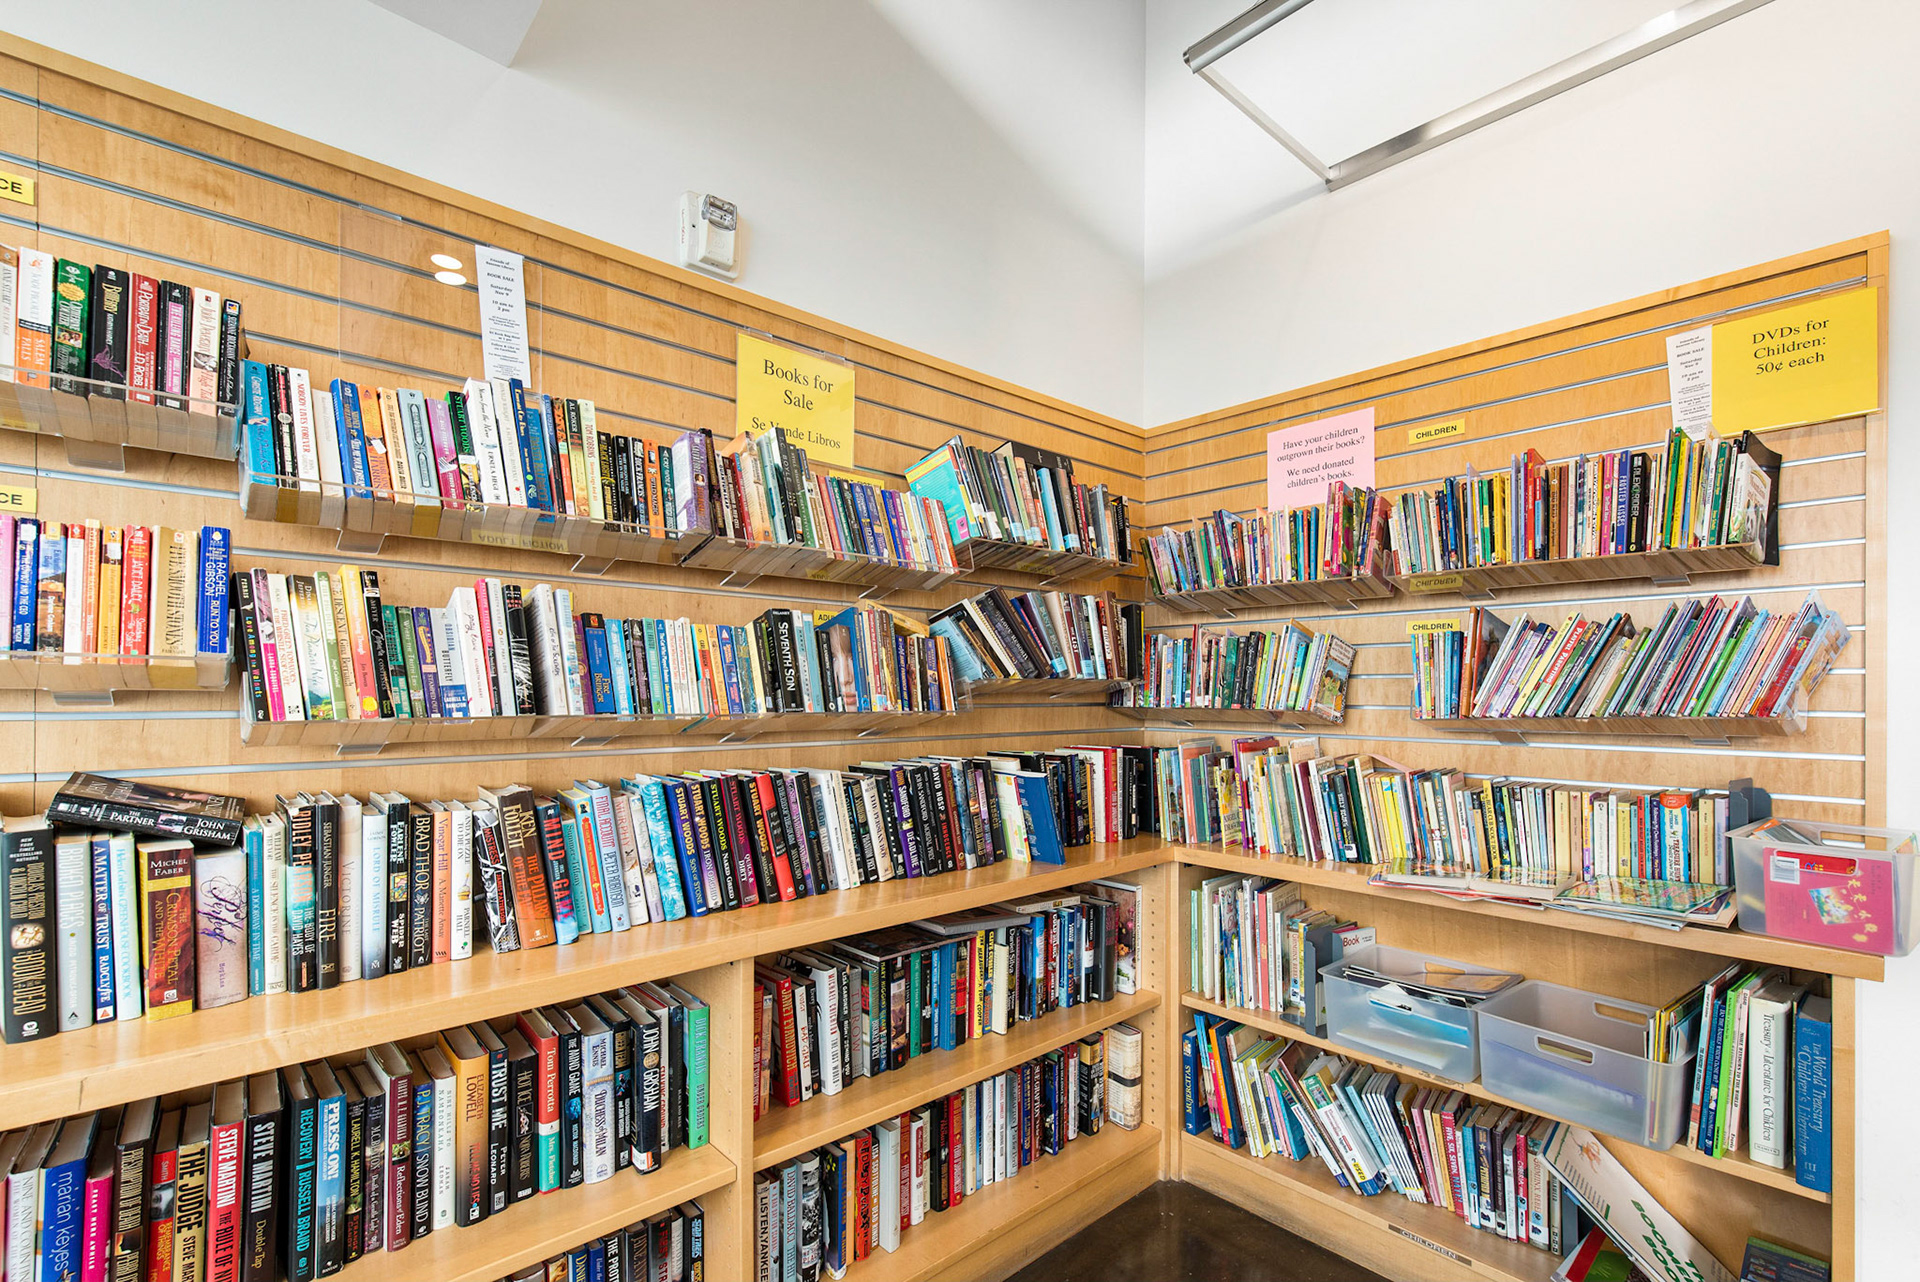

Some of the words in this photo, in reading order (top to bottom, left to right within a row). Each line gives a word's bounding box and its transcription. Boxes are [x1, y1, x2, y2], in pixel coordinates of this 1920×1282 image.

[487, 272, 501, 280] BOOK
[490, 284, 512, 292] Saturday
[1752, 326, 1800, 345] DVDs
[1806, 319, 1830, 332] for
[1753, 336, 1826, 359] Children:
[20, 337, 33, 361] FALLS
[34, 338, 45, 365] SALEM
[1756, 361, 1783, 375] 50¢
[1789, 352, 1825, 368] each
[134, 365, 145, 387] ROBB
[764, 359, 809, 386] Books
[814, 375, 834, 393] for
[453, 395, 466, 424] STUART
[784, 389, 814, 410] Sale
[458, 425, 470, 453] WOODS
[752, 416, 766, 430] Se
[770, 421, 804, 440] Vnde
[808, 431, 841, 449] Libros
[1283, 440, 1303, 450] Have
[1305, 435, 1323, 447] your
[1325, 426, 1359, 441] children
[1416, 425, 1457, 439] CHILDREN
[1277, 449, 1313, 462] outgrown
[1315, 444, 1333, 455] their
[1335, 436, 1365, 450] books?
[781, 453, 792, 482] BOYLE
[1287, 468, 1300, 477] We
[1302, 464, 1321, 474] need
[1322, 457, 1354, 470] donated
[1287, 476, 1325, 489] children's
[1327, 470, 1354, 481] books.
[204, 562, 215, 596] GIBSON
[215, 562, 226, 597] RACHEL
[210, 618, 219, 629] TO
[211, 600, 220, 617] RUN
[245, 616, 255, 632] Love
[209, 630, 219, 646] YOU
[446, 624, 455, 651] OBSIDIAN
[1412, 622, 1453, 631] CHILDREN
[248, 634, 259, 657] Among
[778, 622, 794, 668] SEVENTH
[441, 650, 453, 682] BUTTERFLY
[785, 669, 795, 691] SON
[252, 669, 262, 698] Walnuts
[110, 812, 155, 827] PARTNER
[184, 825, 231, 841] GRISHAM
[196, 818, 225, 831] JOHN
[503, 806, 524, 849] FOLLETT
[520, 811, 537, 837] KEN
[675, 787, 689, 822] STUART
[682, 824, 695, 856] WOODS
[711, 784, 722, 817] STUART
[717, 819, 728, 851] WOODS
[323, 821, 332, 859] SEBASTIAN
[397, 822, 405, 864] EARLENE
[415, 817, 430, 853] BRAD
[435, 818, 449, 851] Vinegar
[483, 828, 501, 865] MISTRESS
[543, 817, 562, 861] MIND
[906, 832, 920, 868] DEADLINE
[941, 822, 952, 858] INNOCENCE
[151, 859, 188, 869] MICHEL
[155, 866, 184, 876] FABER
[323, 860, 332, 889] JUNGER
[372, 847, 381, 872] LORD
[414, 855, 430, 892] THOR
[438, 853, 448, 872] Hill
[94, 856, 107, 901] MATTER
[59, 891, 85, 929] PLACES
[341, 861, 354, 936] VICTORINE
[372, 892, 381, 932] MISRULE
[96, 914, 109, 950] TRUST
[166, 893, 182, 944] CRIMSON
[319, 908, 336, 943] FIRE
[391, 920, 399, 945] WEB
[413, 907, 425, 953] PATRIOT
[1343, 937, 1360, 947] Book
[151, 939, 166, 979] WHITE
[167, 948, 182, 984] PETAL
[781, 989, 793, 1017] JANET
[851, 989, 861, 1053] TUROW
[1760, 1014, 1775, 1048] Treasury
[643, 1028, 658, 1053] JOHN
[782, 1019, 797, 1070] EVANOVICH
[546, 1048, 557, 1069] Tom
[568, 1049, 580, 1071] MIND
[1762, 1055, 1774, 1092] Literature
[1813, 1055, 1827, 1088] World
[491, 1059, 507, 1105] TRUST
[546, 1072, 557, 1113] Perrotta
[569, 1071, 580, 1096] GAME
[643, 1069, 659, 1112] GRISHAM
[1186, 1065, 1194, 1114] MUJERCITAS
[1797, 1051, 1813, 1102] Children's
[466, 1076, 478, 1122] LOWELL
[1762, 1095, 1774, 1106] for
[1808, 1088, 1826, 1132] Treasury
[253, 1121, 275, 1160] STEVE
[299, 1108, 314, 1161] RECOVERY
[327, 1101, 340, 1152] PRESS
[351, 1119, 361, 1149] LAURELL
[416, 1110, 430, 1145] TRACY
[1762, 1108, 1775, 1141] Children
[1797, 1104, 1811, 1155] Literature
[219, 1128, 238, 1160] STEVE
[161, 1161, 169, 1181] SMITH
[178, 1148, 206, 1180] THE
[328, 1154, 340, 1180] ON!
[350, 1160, 361, 1197] HAMILTON
[416, 1154, 428, 1187] SNOW
[1353, 1162, 1366, 1181] USED
[57, 1171, 73, 1223] marian
[216, 1161, 237, 1209] MARTINI
[250, 1161, 273, 1214] MARTINI
[297, 1169, 314, 1216] RUSSELL
[787, 1171, 797, 1199] DAVID
[177, 1183, 204, 1234] JUDGE
[416, 1191, 428, 1222] BLIND
[787, 1200, 796, 1243] BALDACCI
[255, 1219, 266, 1251] Double
[297, 1217, 310, 1252] BRAND
[1401, 1230, 1456, 1259] CHILDREN
